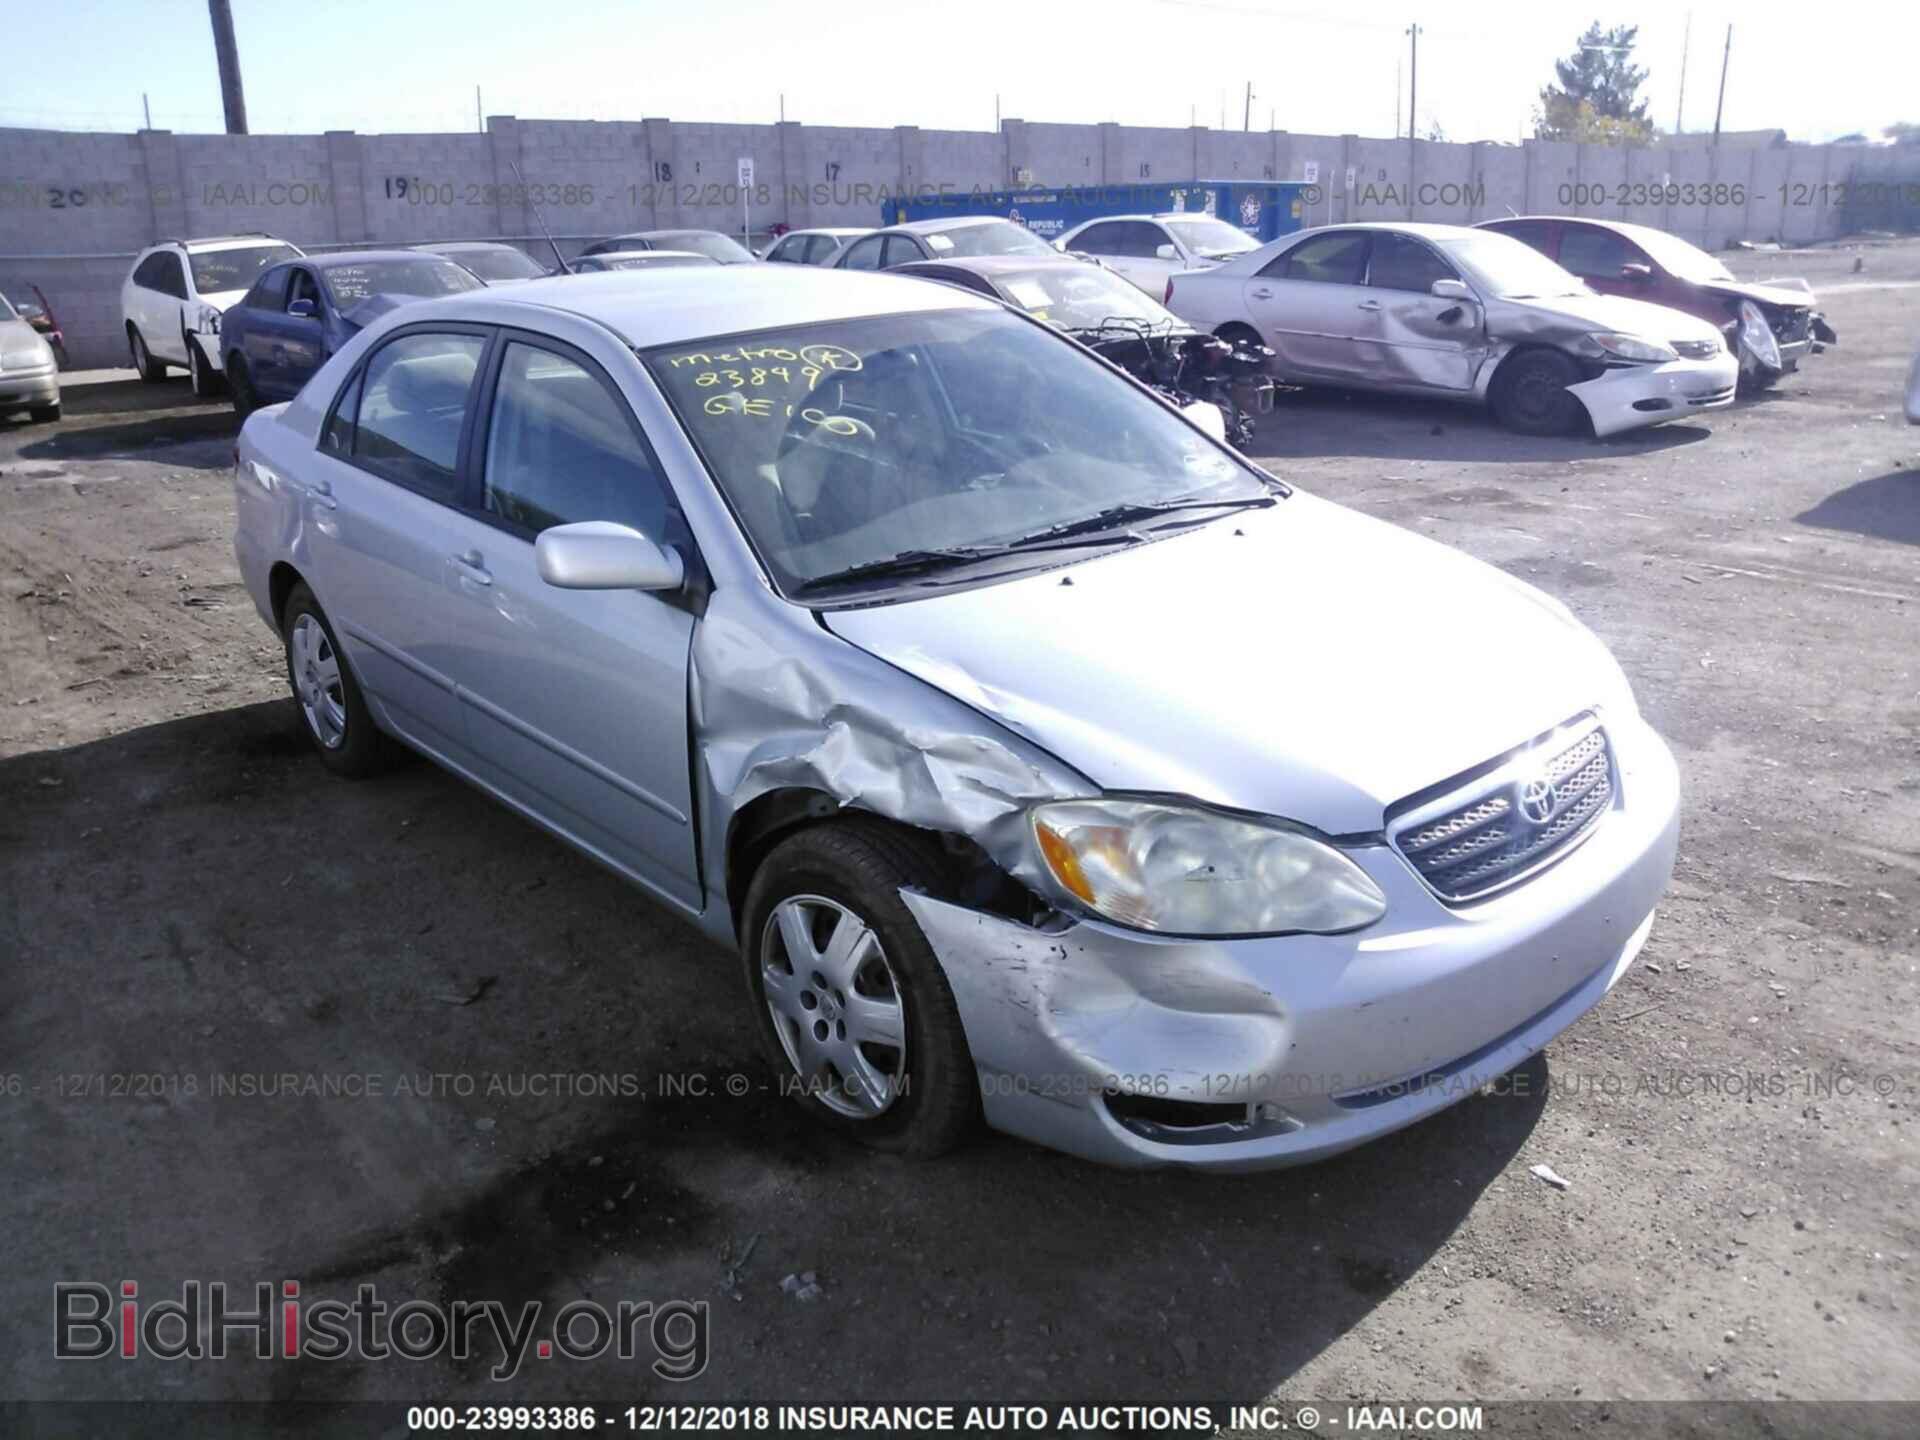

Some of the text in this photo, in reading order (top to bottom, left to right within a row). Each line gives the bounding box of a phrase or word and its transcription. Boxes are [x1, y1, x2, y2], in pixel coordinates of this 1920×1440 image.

[655, 161, 673, 182] 18
[825, 162, 840, 181] 17
[385, 177, 408, 198] 19
